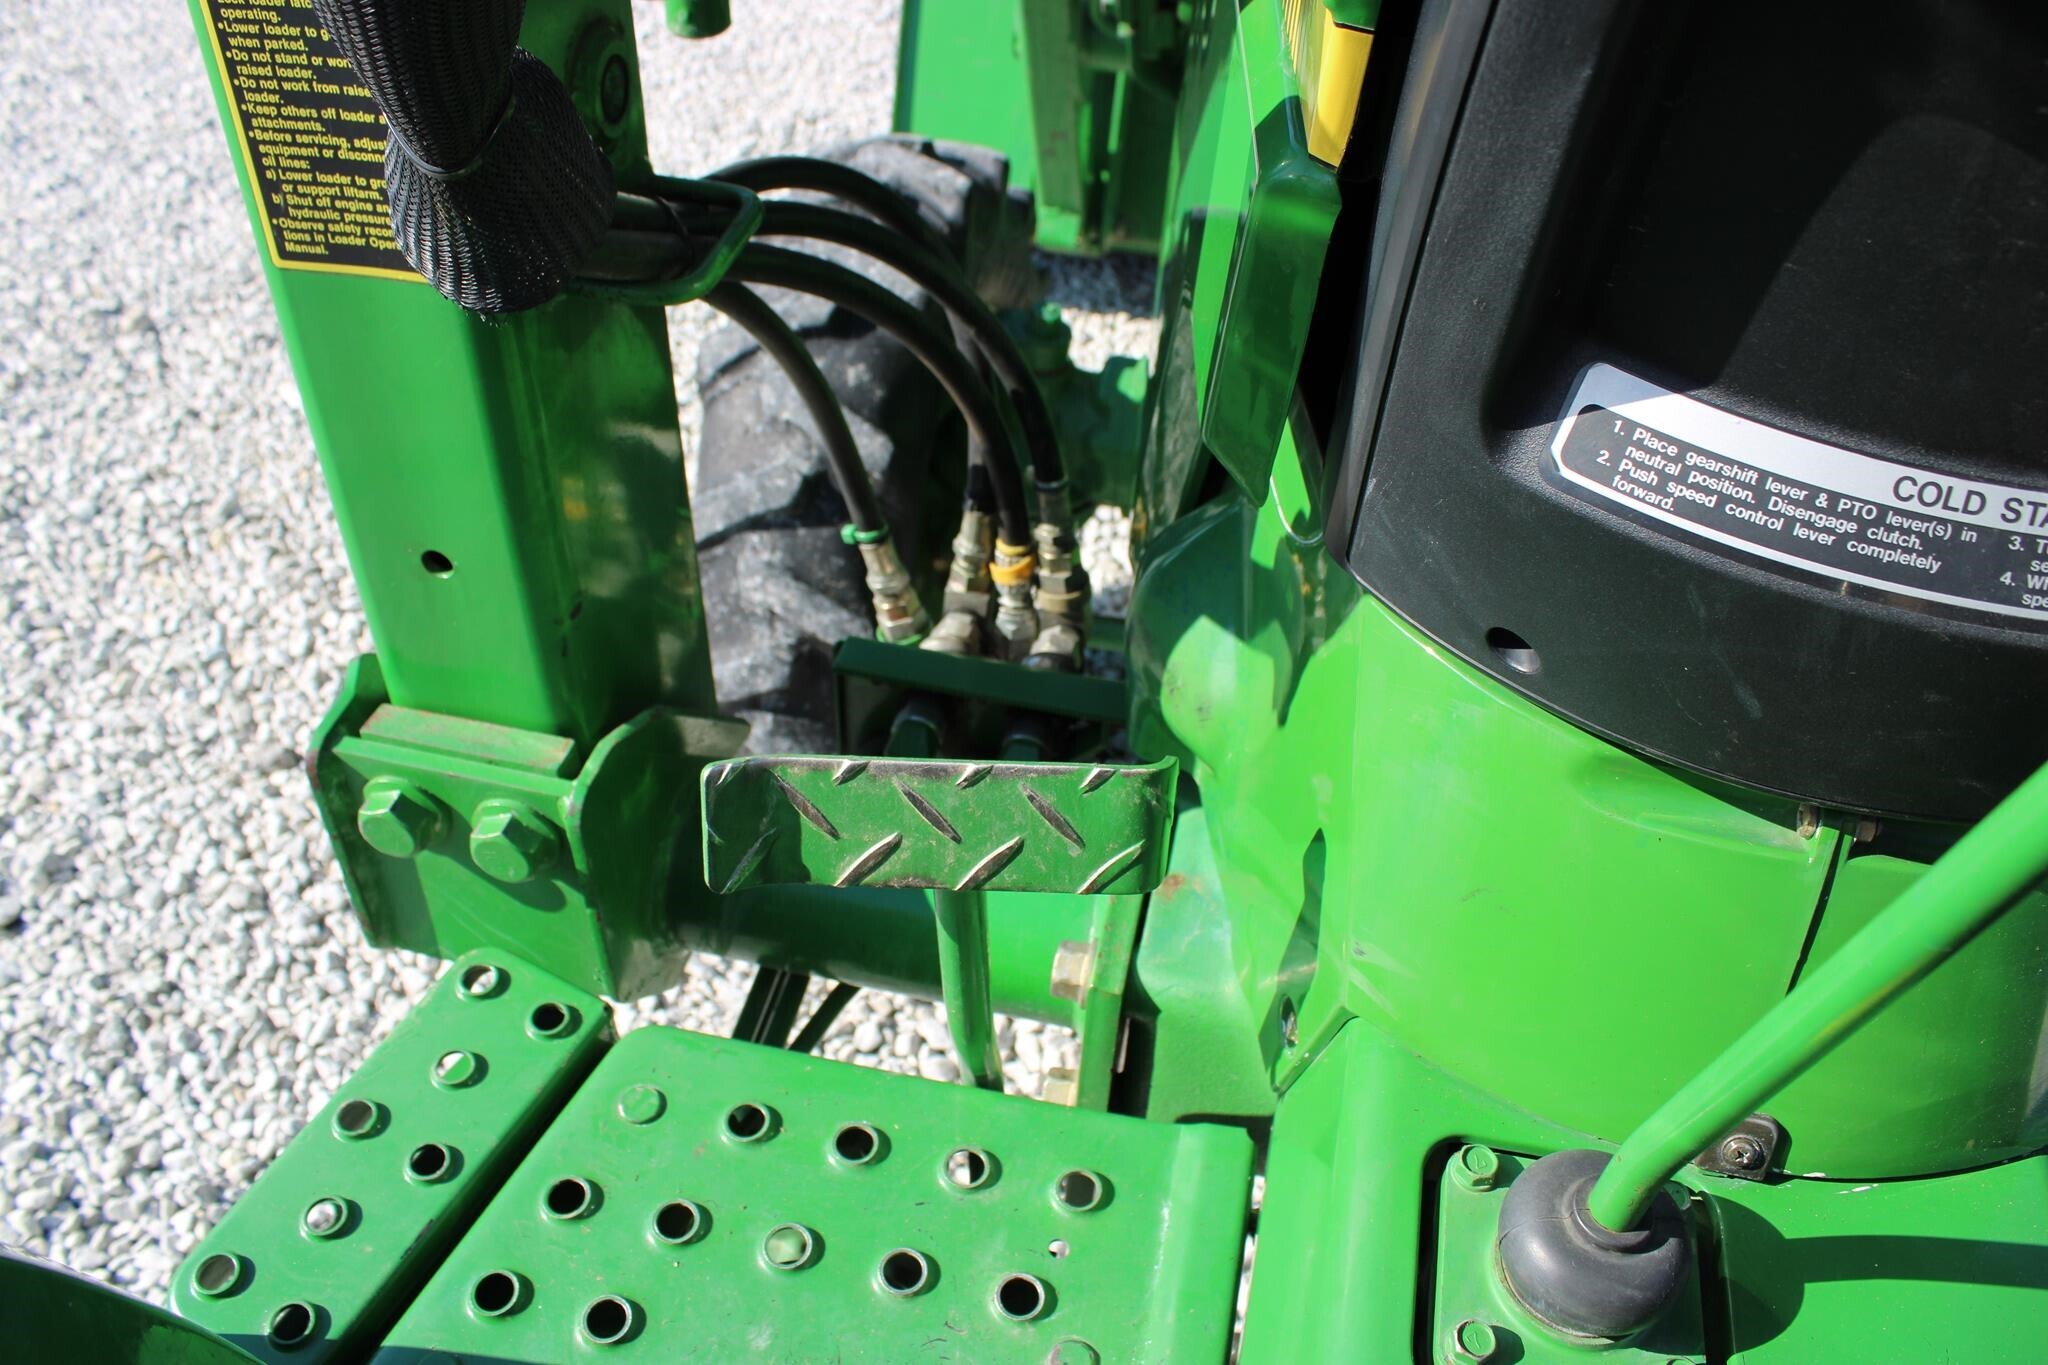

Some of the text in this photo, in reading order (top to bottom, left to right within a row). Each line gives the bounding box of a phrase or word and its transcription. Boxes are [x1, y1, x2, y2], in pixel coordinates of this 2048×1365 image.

[290, 0, 313, 8] latc
[220, 8, 281, 23] operating.
[224, 21, 259, 34] Lower
[263, 23, 300, 36] loader
[304, 26, 317, 38] to
[228, 36, 308, 52] when parked.
[232, 50, 248, 61] Do
[252, 51, 272, 62] not
[275, 52, 308, 65] stand
[311, 56, 323, 66] or
[236, 64, 317, 79] raised loader.
[240, 78, 372, 98] Do not work from raise
[244, 90, 284, 104] loader.
[248, 103, 277, 117] Keep
[281, 105, 318, 118] others
[321, 108, 336, 120] off
[340, 108, 375, 123] loader
[252, 118, 326, 132] attachments.
[254, 130, 292, 142] Before
[354, 137, 387, 151] adjust
[259, 144, 385, 162] equipment or disconn
[262, 155, 310, 169] oil lines:
[266, 170, 388, 190] a) Lower loader to gro
[282, 183, 383, 200] or support liftarm.
[272, 193, 390, 213] b) Shut off engine an
[288, 206, 341, 220] hydraulic
[278, 218, 394, 237] Observe safety reco
[284, 230, 311, 242] tions
[314, 232, 325, 242] in
[328, 232, 366, 246] Loader
[284, 242, 328, 254] Manual.
[1614, 420, 1978, 543] 1. Place gearshift lever & PTO lever(s) in
[1612, 474, 1674, 512] forward.
[1625, 446, 1924, 550] neutral position. Disengage clutch.
[1892, 475, 2048, 528] COLD ST
[1596, 450, 1942, 574] 2. Push speed control lever completely
[2008, 535, 2024, 552] 3.
[2030, 560, 2048, 573] se
[2000, 571, 2016, 586] 4.
[2021, 593, 2048, 608] spe
